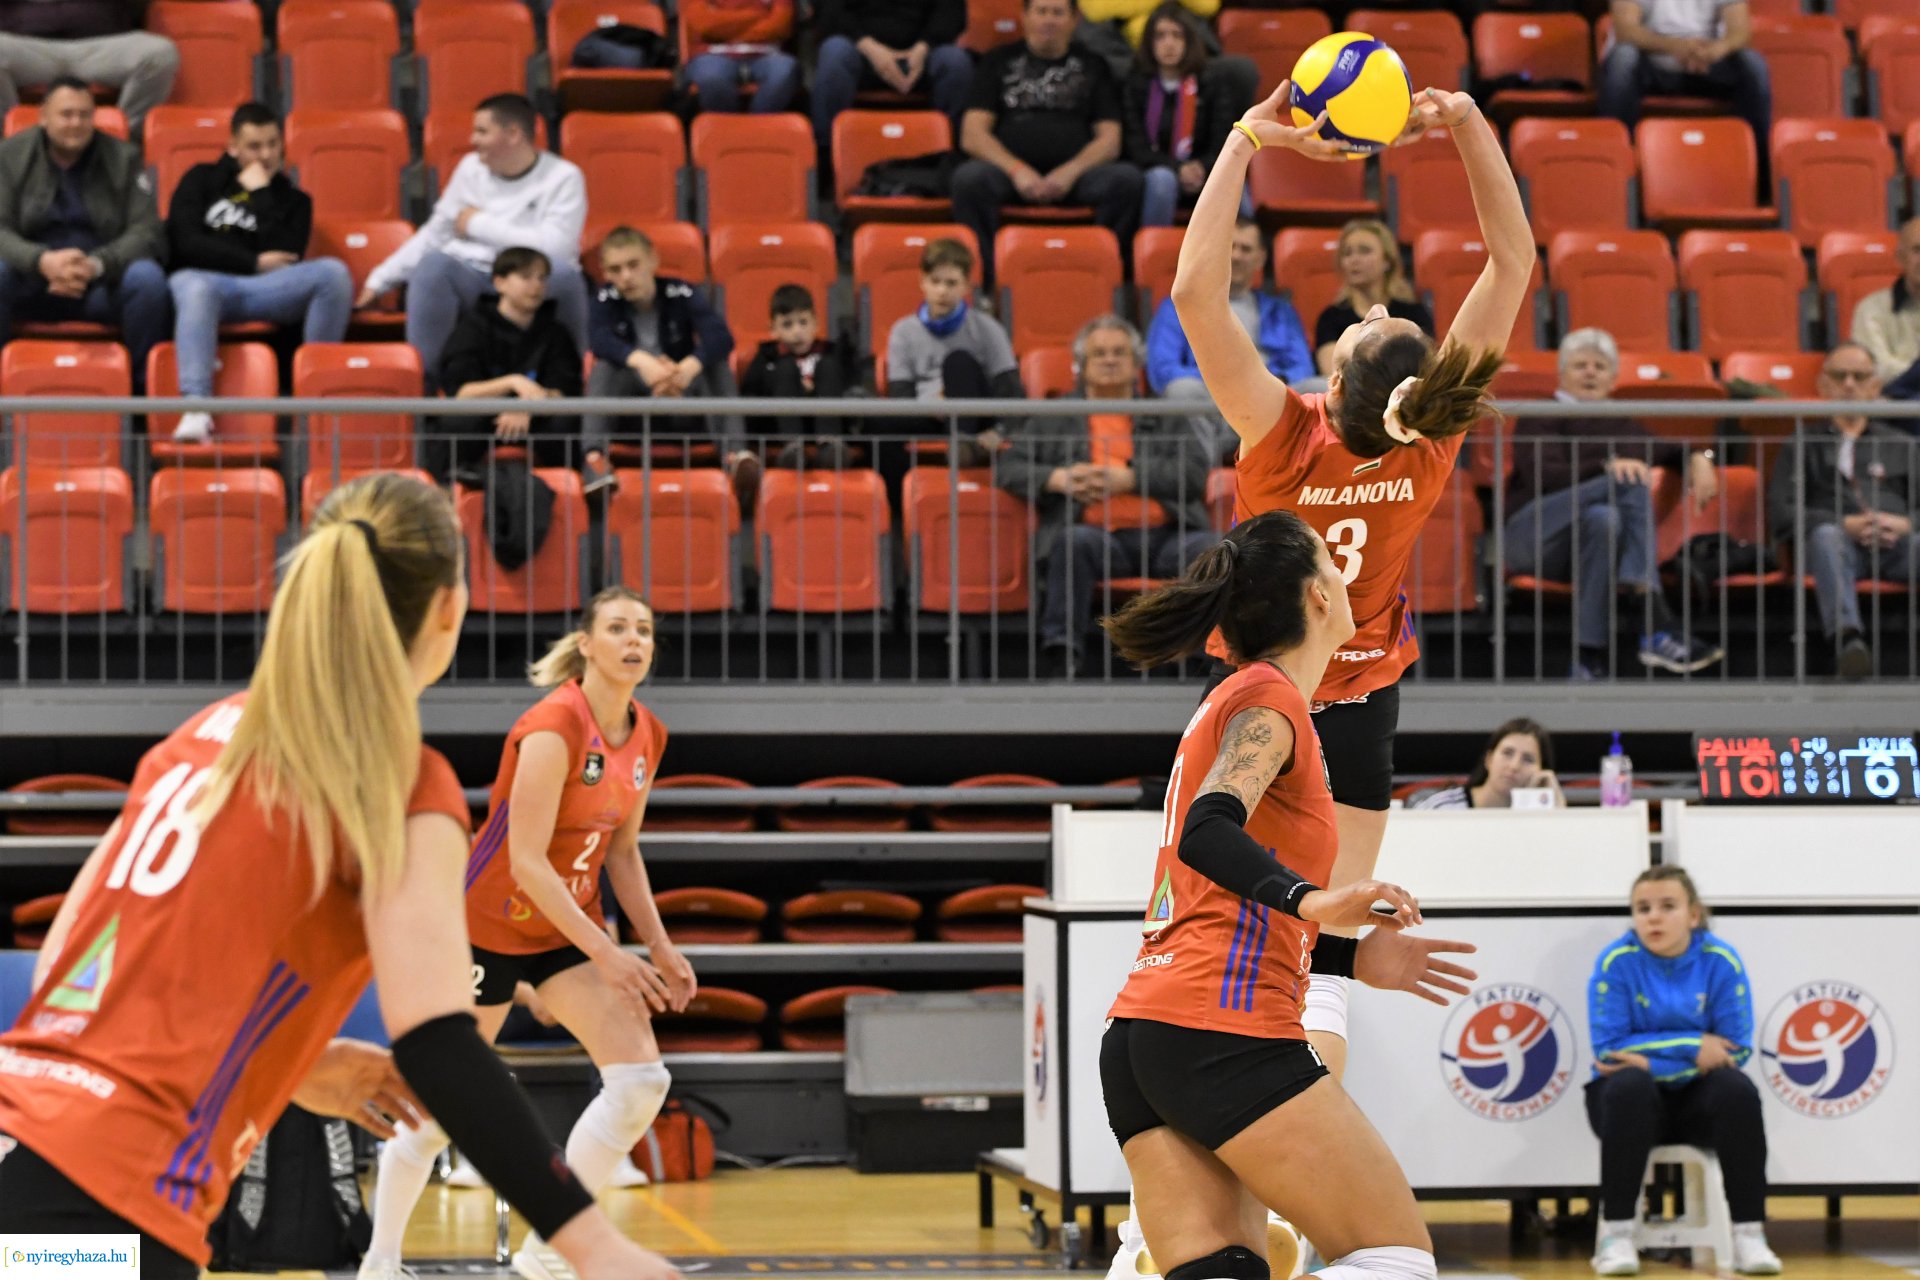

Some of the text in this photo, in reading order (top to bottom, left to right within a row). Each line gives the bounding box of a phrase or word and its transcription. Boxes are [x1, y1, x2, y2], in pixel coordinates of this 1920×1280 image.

[1297, 478, 1414, 505] MILANOVA
[1326, 518, 1368, 586] 3
[105, 762, 224, 897] 18
[572, 831, 600, 871] 2
[1473, 986, 1541, 1007] FATUM
[1793, 984, 1861, 1004] FATUM
